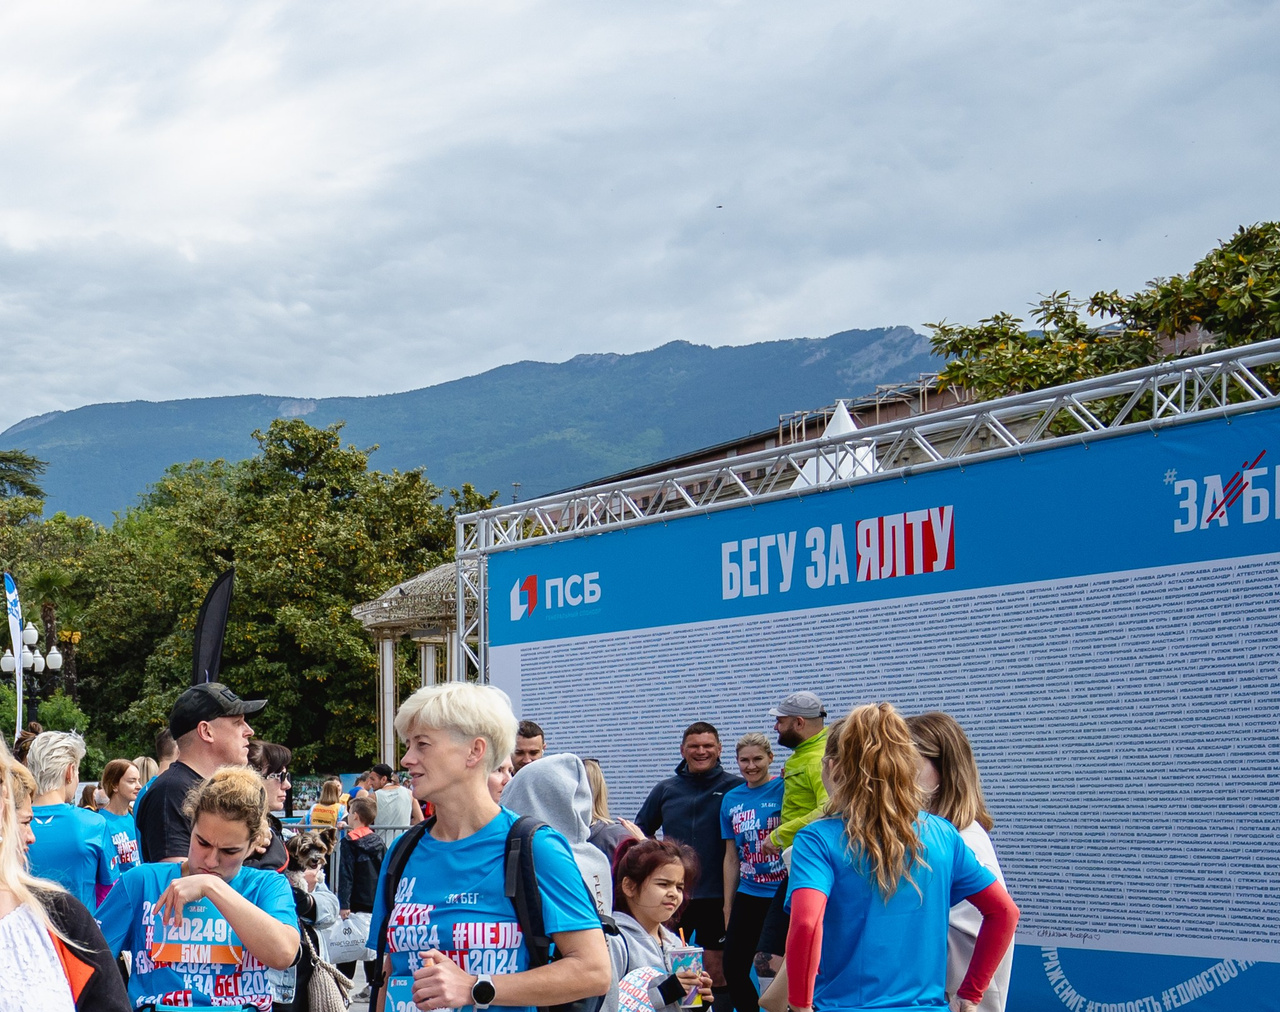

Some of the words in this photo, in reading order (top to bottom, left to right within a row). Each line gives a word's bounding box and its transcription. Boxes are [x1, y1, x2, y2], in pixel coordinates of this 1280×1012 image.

[722, 531, 797, 600] БЕГУ
[805, 523, 850, 589] ЗА
[856, 505, 956, 582] ЯЛТУ
[545, 571, 602, 610] ПСБ
[593, 875, 605, 915] PLEAS
[168, 918, 227, 942] 20249
[453, 922, 523, 949] #ЦЕЛЬ
[181, 944, 211, 963] 5KM
[184, 972, 270, 997] #ЗАБЕГ202
[1162, 958, 1238, 1011] #ЕДИНСТВО
